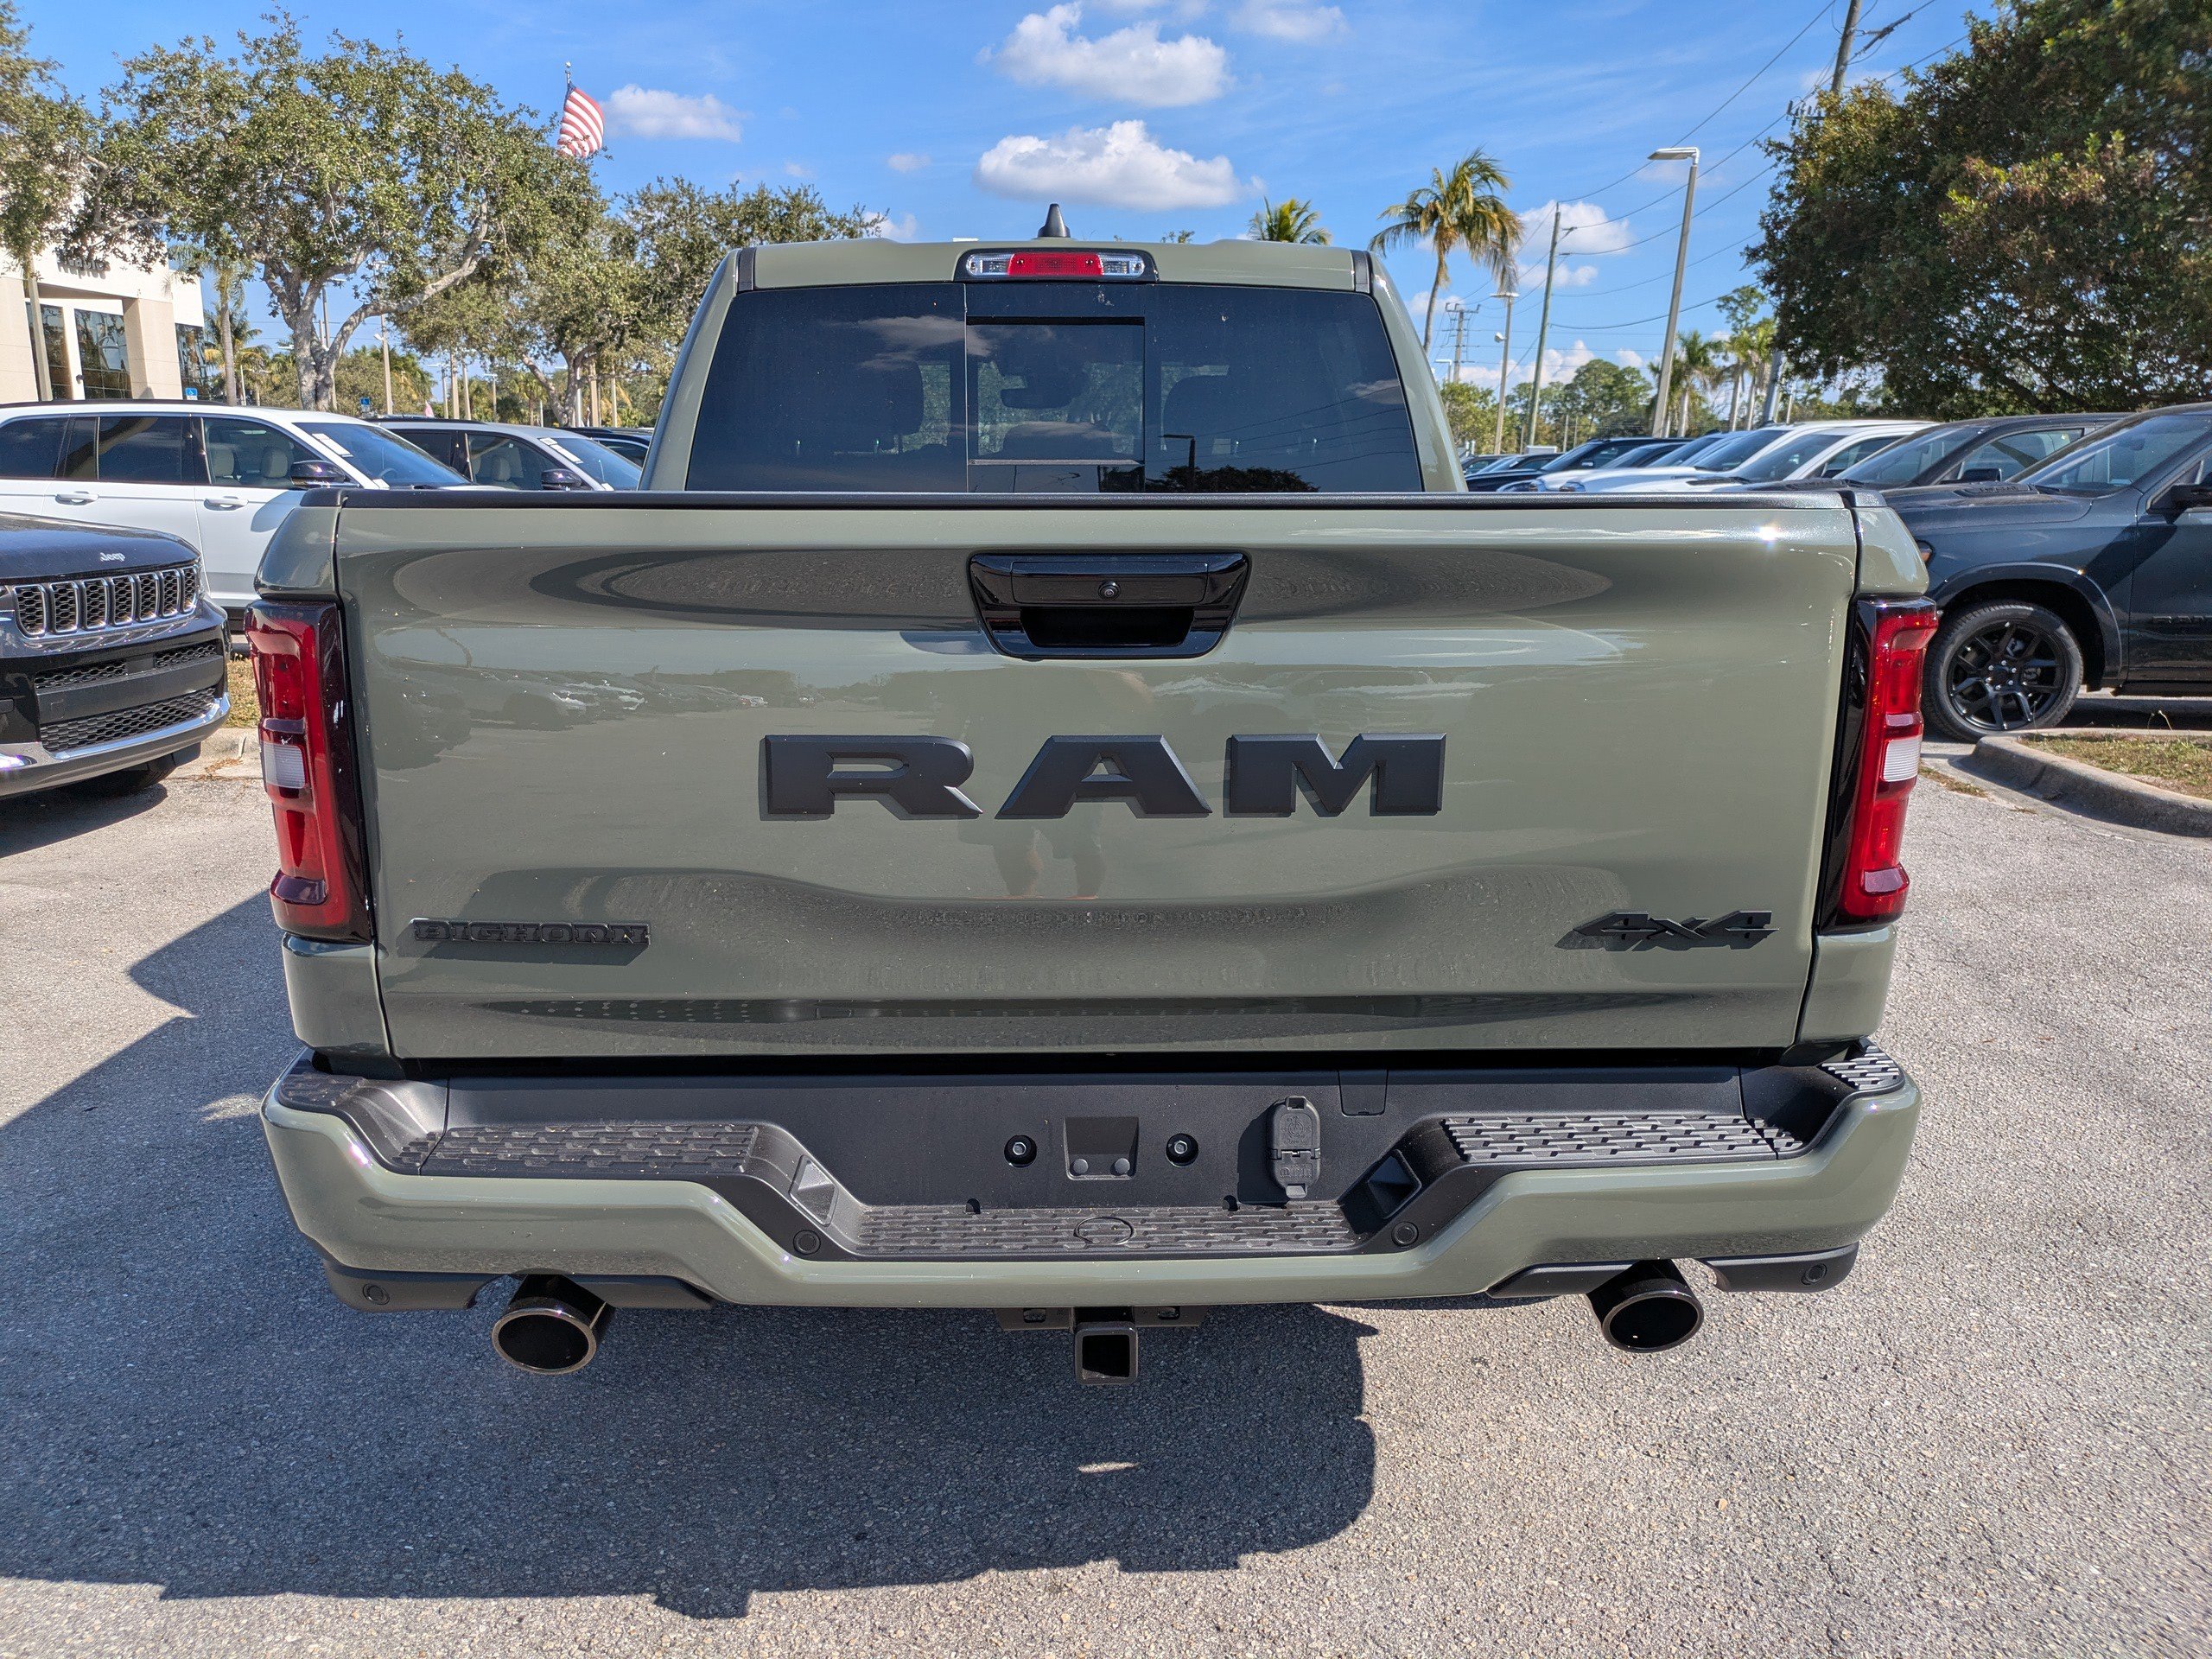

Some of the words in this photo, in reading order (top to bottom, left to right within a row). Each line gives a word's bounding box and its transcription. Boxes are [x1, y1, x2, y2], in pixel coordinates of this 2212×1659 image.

[99, 552, 125, 562] Jeep
[764, 734, 1447, 817] RAM
[408, 918, 652, 945] BIGHORN
